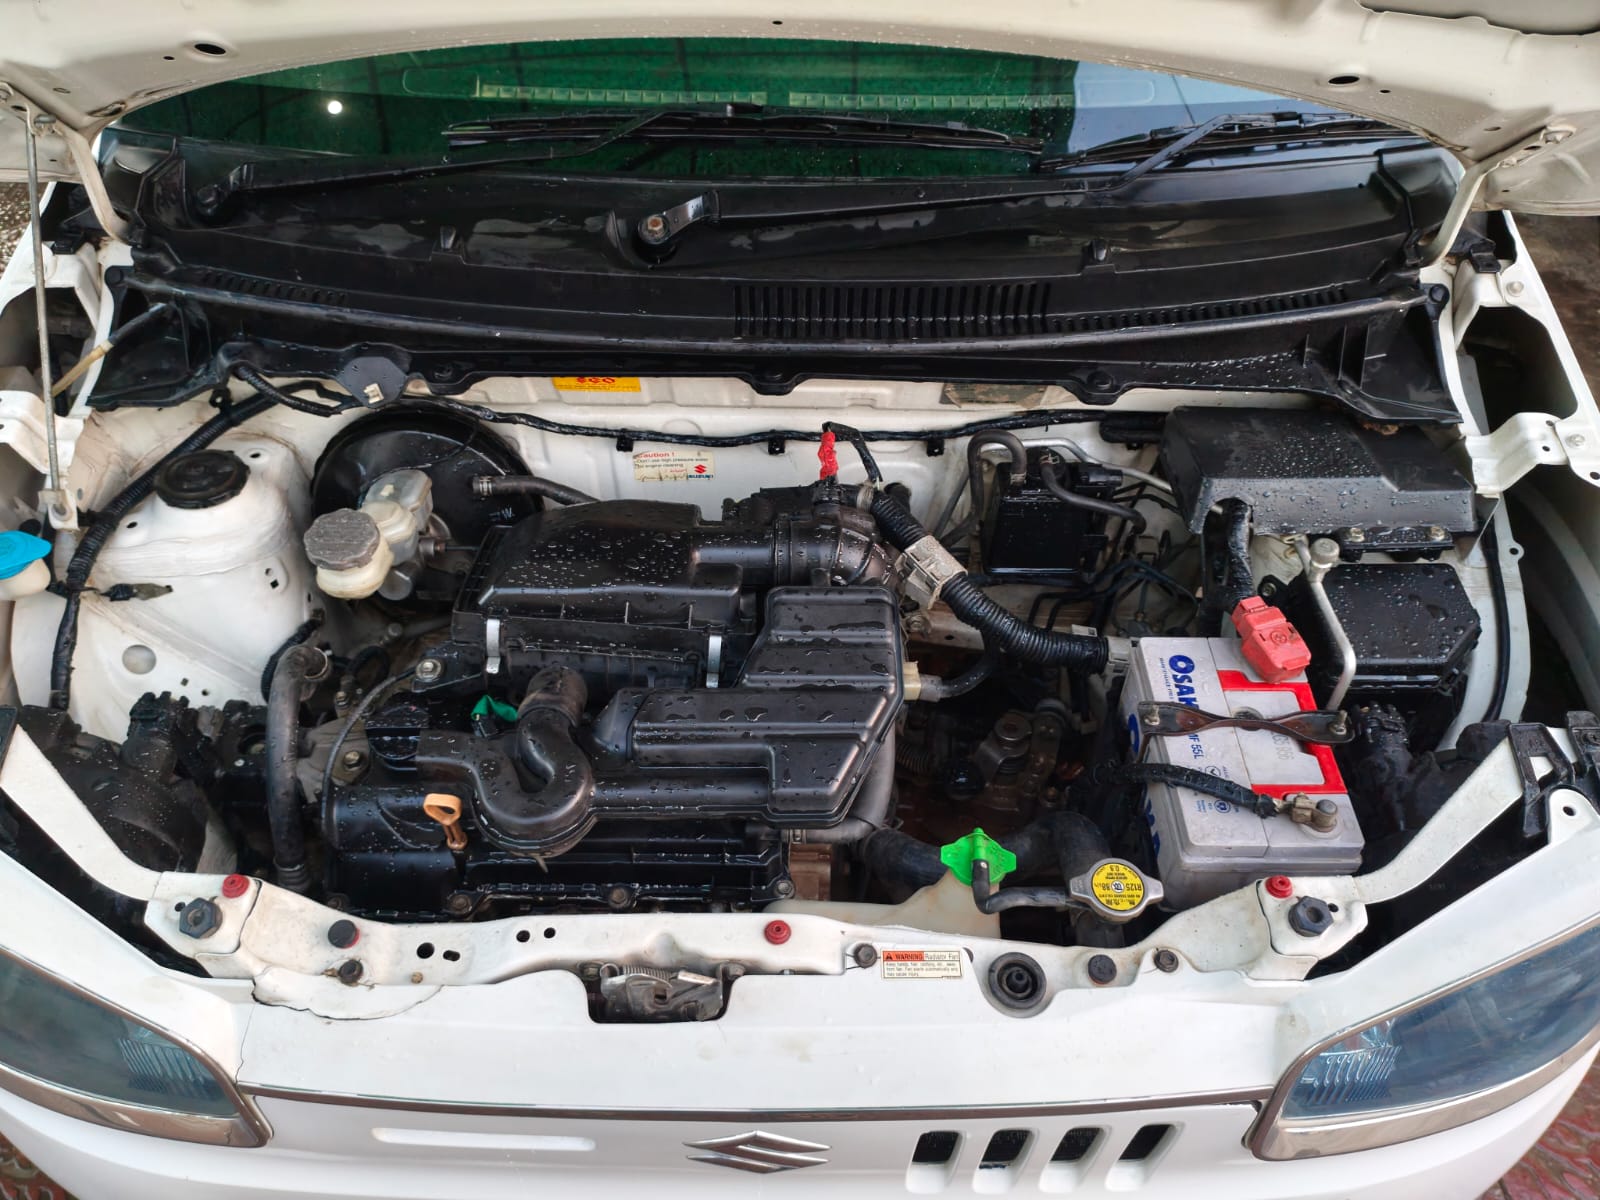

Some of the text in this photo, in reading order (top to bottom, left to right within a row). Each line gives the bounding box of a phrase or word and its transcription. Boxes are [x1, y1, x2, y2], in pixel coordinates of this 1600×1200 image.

[1125, 883, 1142, 891] R125
[895, 952, 960, 960] WARNING Radiator Fan
